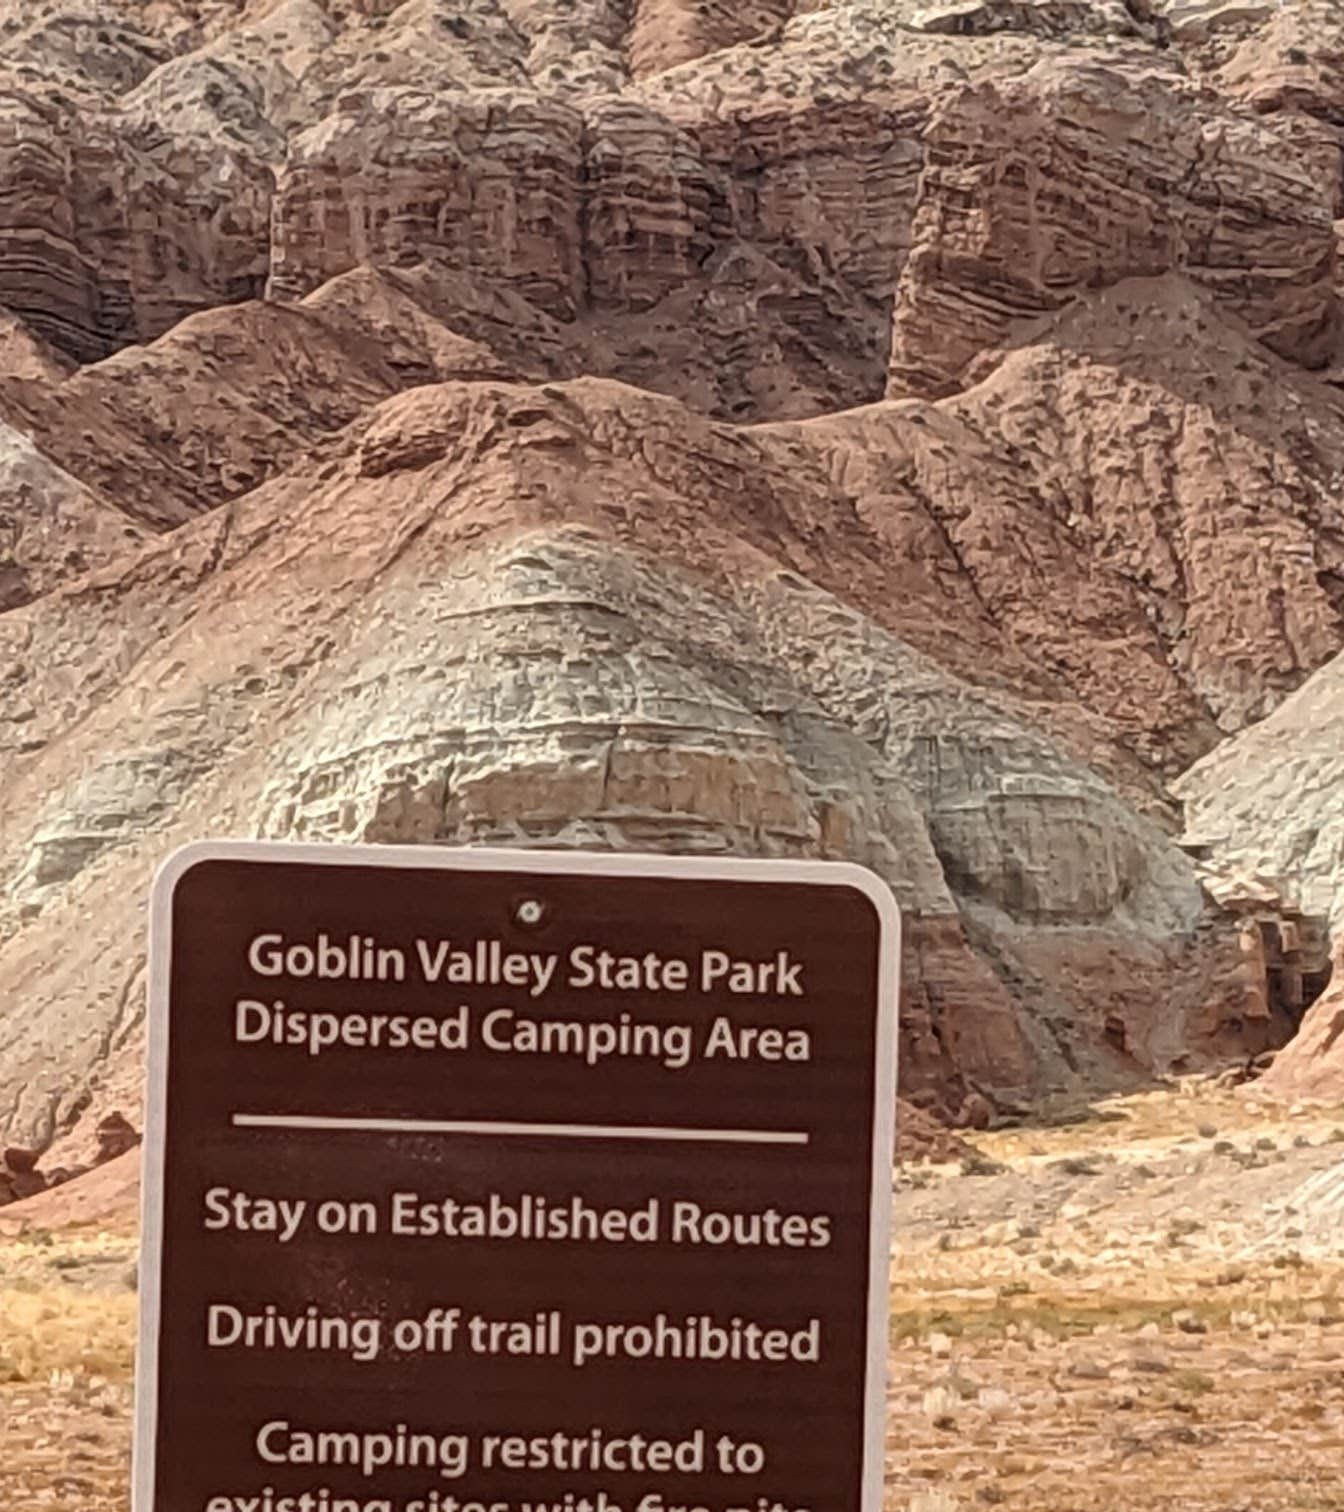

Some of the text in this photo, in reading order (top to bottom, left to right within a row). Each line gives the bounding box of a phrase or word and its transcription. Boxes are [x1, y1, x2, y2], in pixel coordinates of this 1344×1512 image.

[250, 935, 802, 995] Goblin Valley State Park
[237, 1001, 808, 1067] Dispersed Camping Area
[206, 1188, 830, 1246] Stay on Established Routes
[209, 1306, 819, 1365] Driving off trail prohibited
[257, 1422, 763, 1477] Camping restricted to
